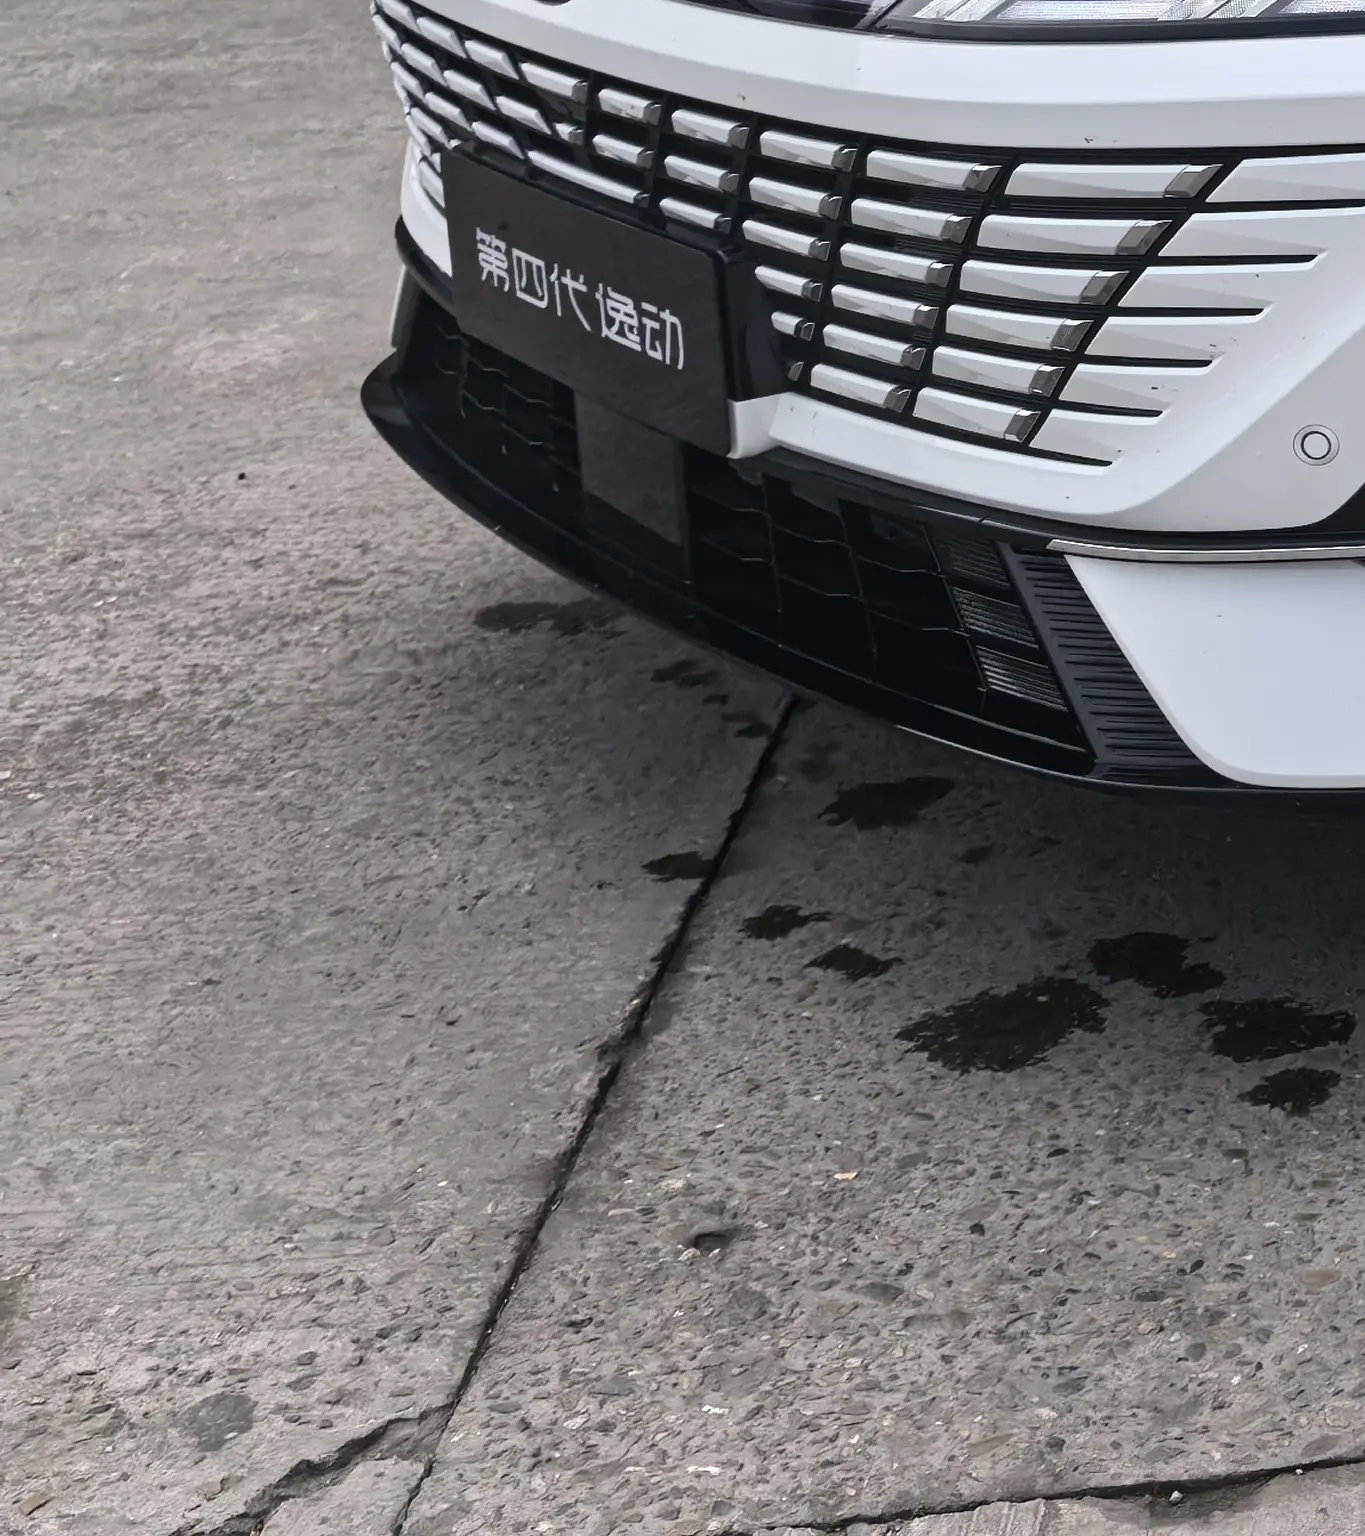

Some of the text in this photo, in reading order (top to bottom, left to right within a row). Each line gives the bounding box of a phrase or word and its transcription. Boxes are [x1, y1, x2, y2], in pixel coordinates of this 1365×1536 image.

[475, 226, 684, 370] 第四代逸动
